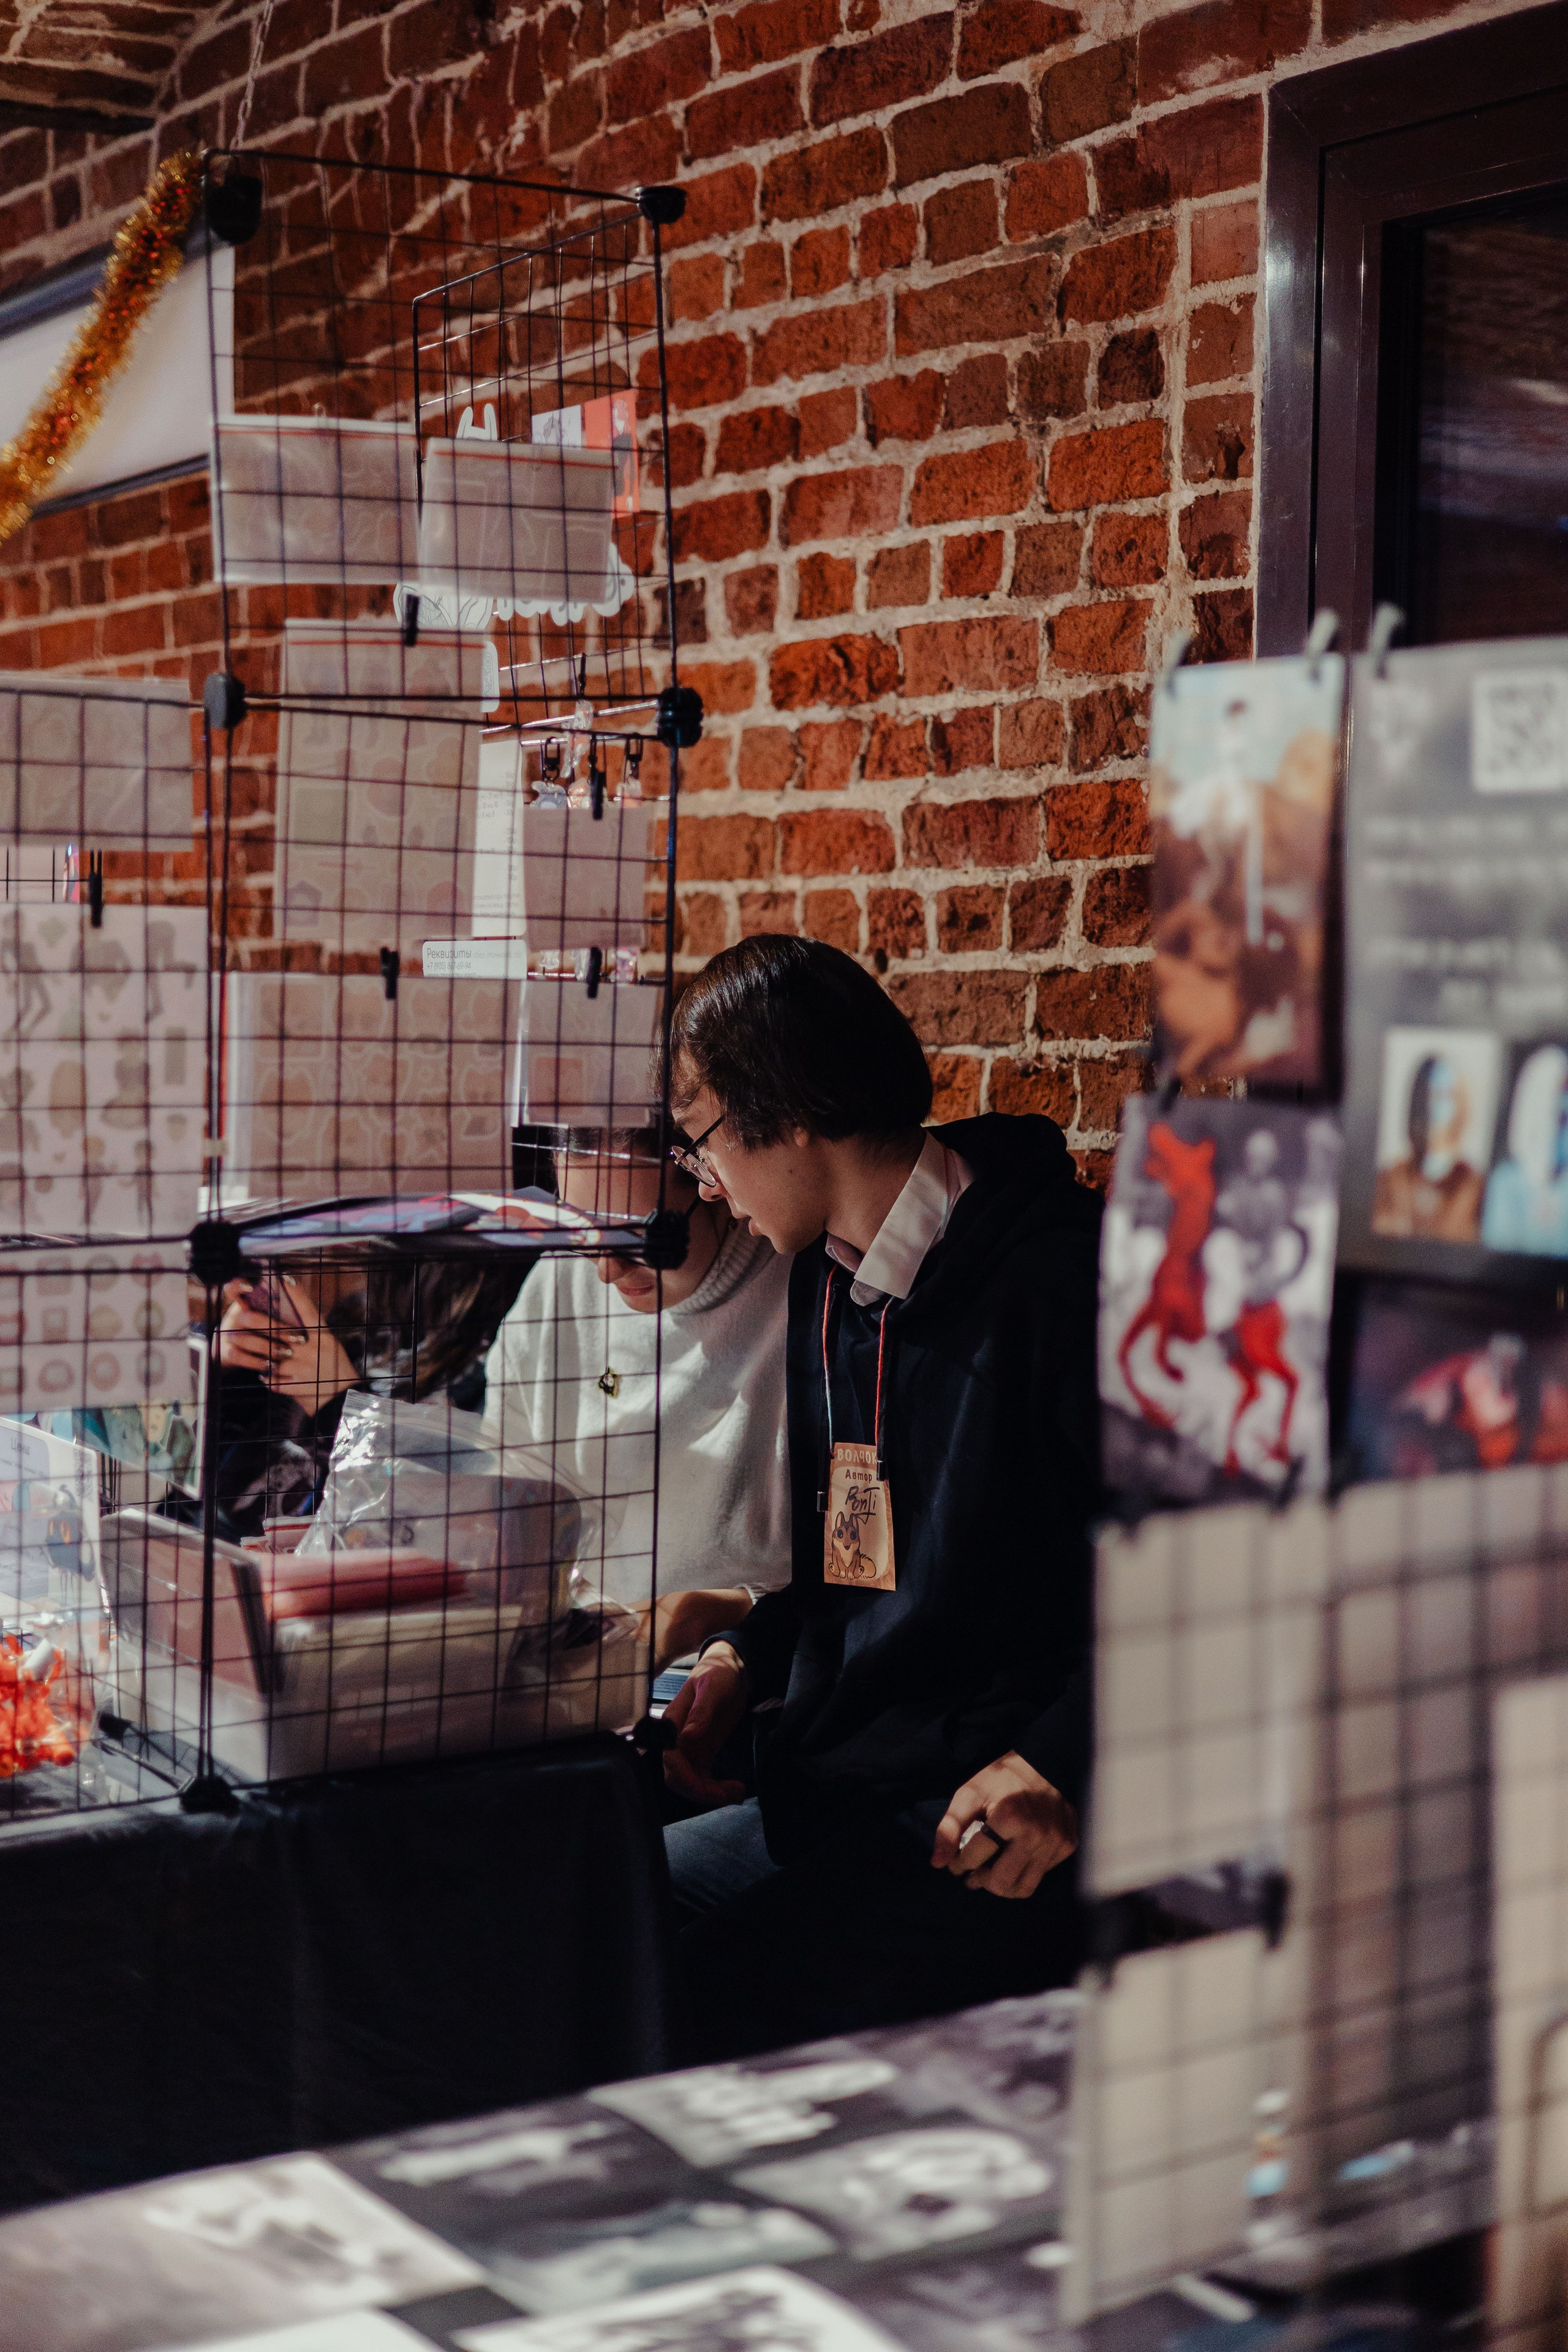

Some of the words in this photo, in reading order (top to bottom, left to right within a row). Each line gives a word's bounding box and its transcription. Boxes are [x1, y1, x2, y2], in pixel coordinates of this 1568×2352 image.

[427, 948, 472, 959] Реквизиты
[427, 962, 433, 971] +7
[837, 1448, 877, 1465] ВОЛЧОК
[845, 1469, 872, 1483] Автор
